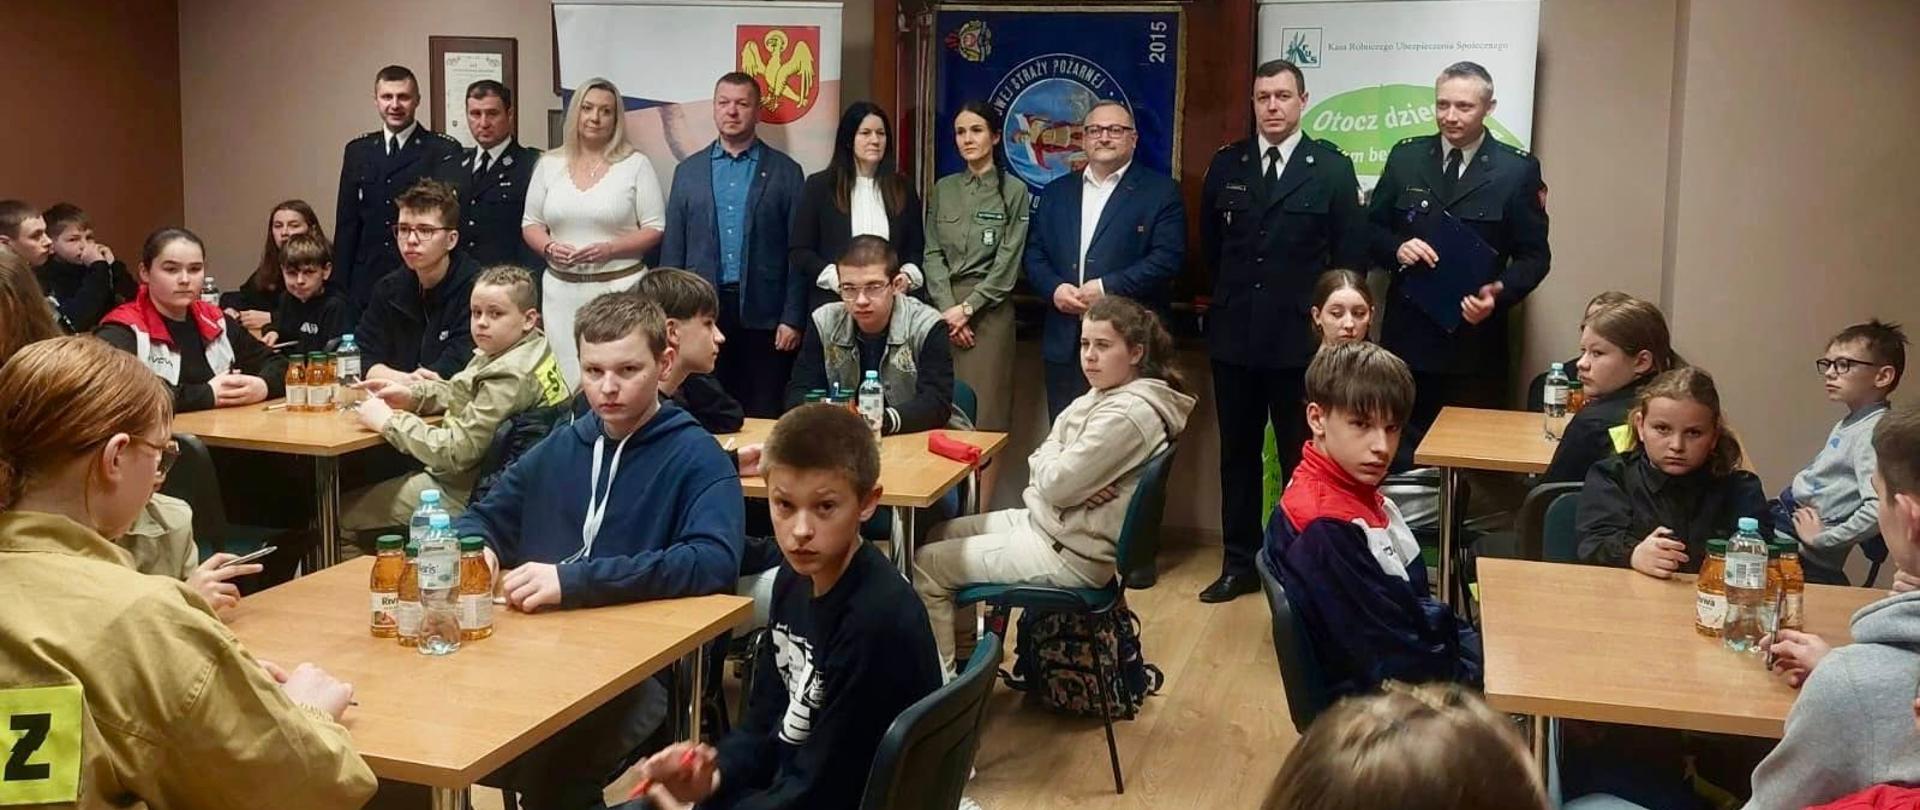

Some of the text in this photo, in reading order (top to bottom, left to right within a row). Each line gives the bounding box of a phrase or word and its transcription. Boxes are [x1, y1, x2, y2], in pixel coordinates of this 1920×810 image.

[1149, 21, 1167, 63] 2015
[1010, 60, 1048, 90] STRAŻY
[1052, 58, 1106, 89] POŻARNEJ
[1313, 110, 1379, 132] Otocz
